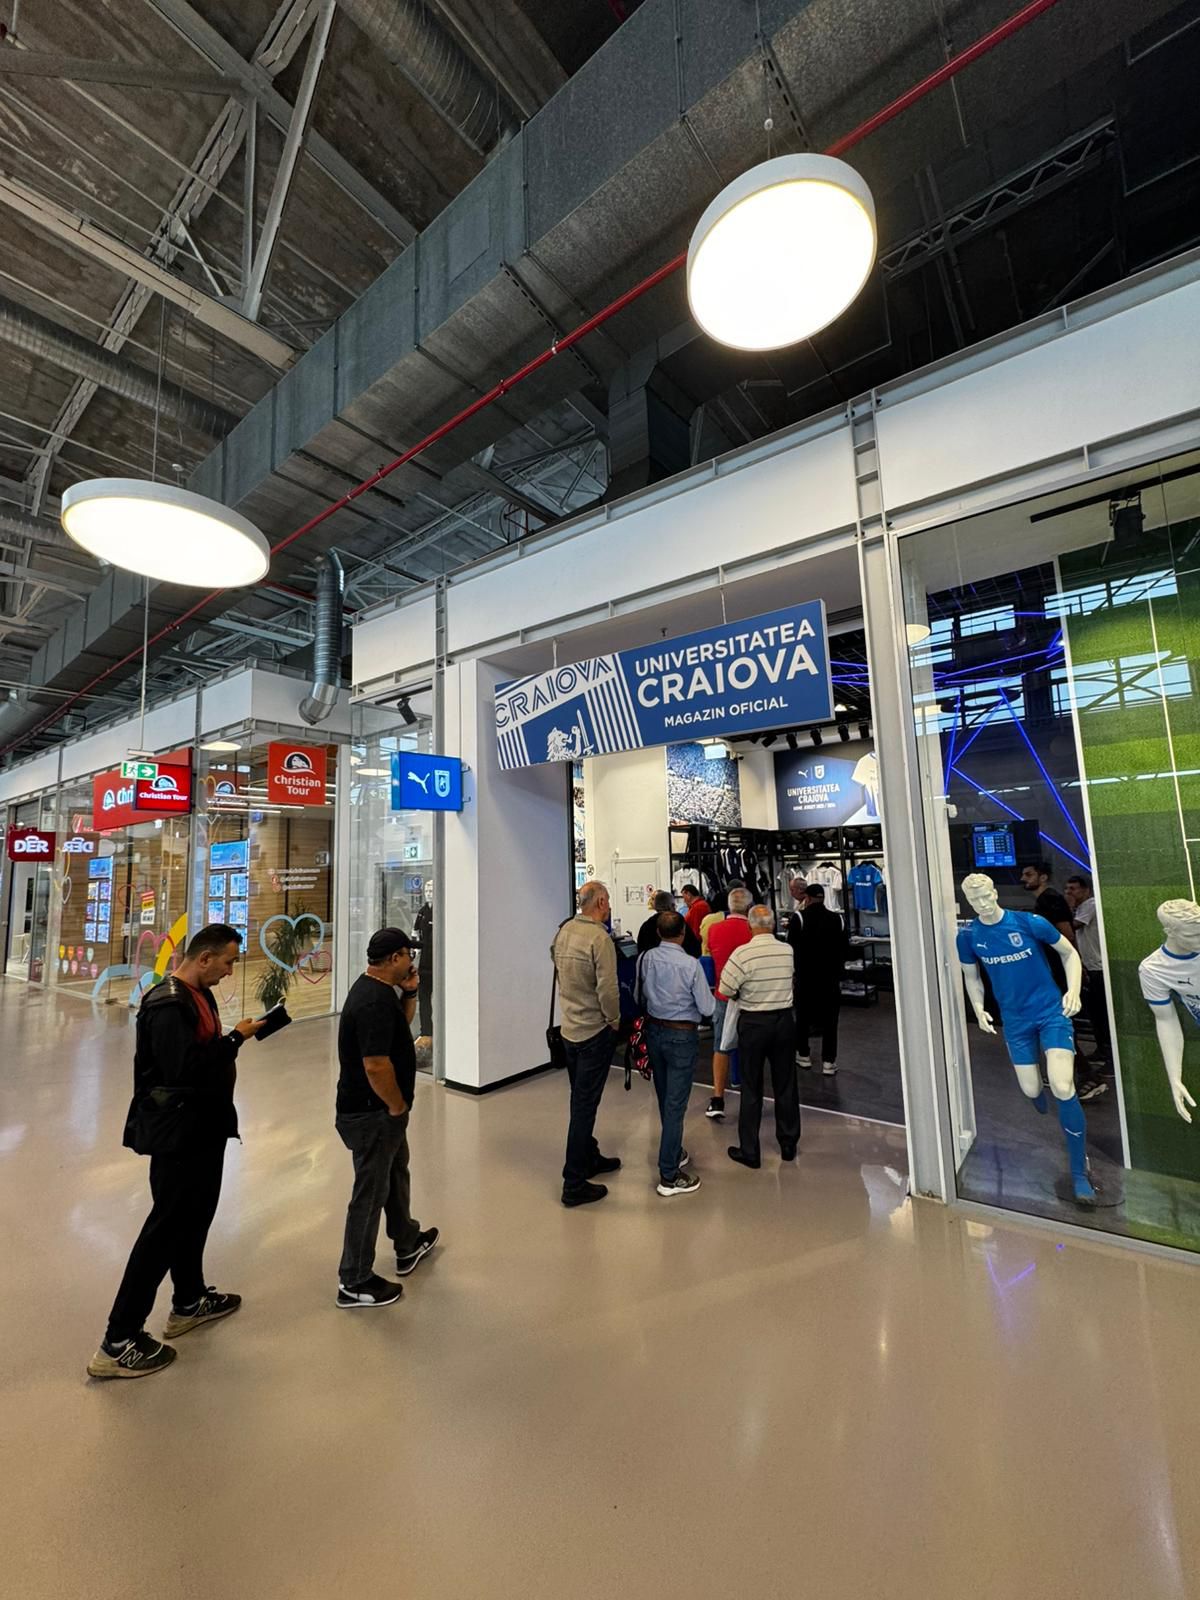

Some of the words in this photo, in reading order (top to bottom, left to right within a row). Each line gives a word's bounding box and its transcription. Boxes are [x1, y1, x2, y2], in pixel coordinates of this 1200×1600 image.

[635, 619, 816, 677] UNIVERSITATEA
[637, 644, 819, 708] CRAIOVA
[496, 657, 612, 728] CRAIOVA
[664, 707, 725, 728] MAGAZIN
[729, 696, 788, 716] OFICIAL
[274, 774, 321, 787] Christian
[139, 792, 171, 800] Christian
[286, 785, 310, 796] Tour
[787, 783, 840, 797] UNIVERSITATEA
[14, 839, 49, 853] DER
[981, 948, 1033, 965] SUPERBET
